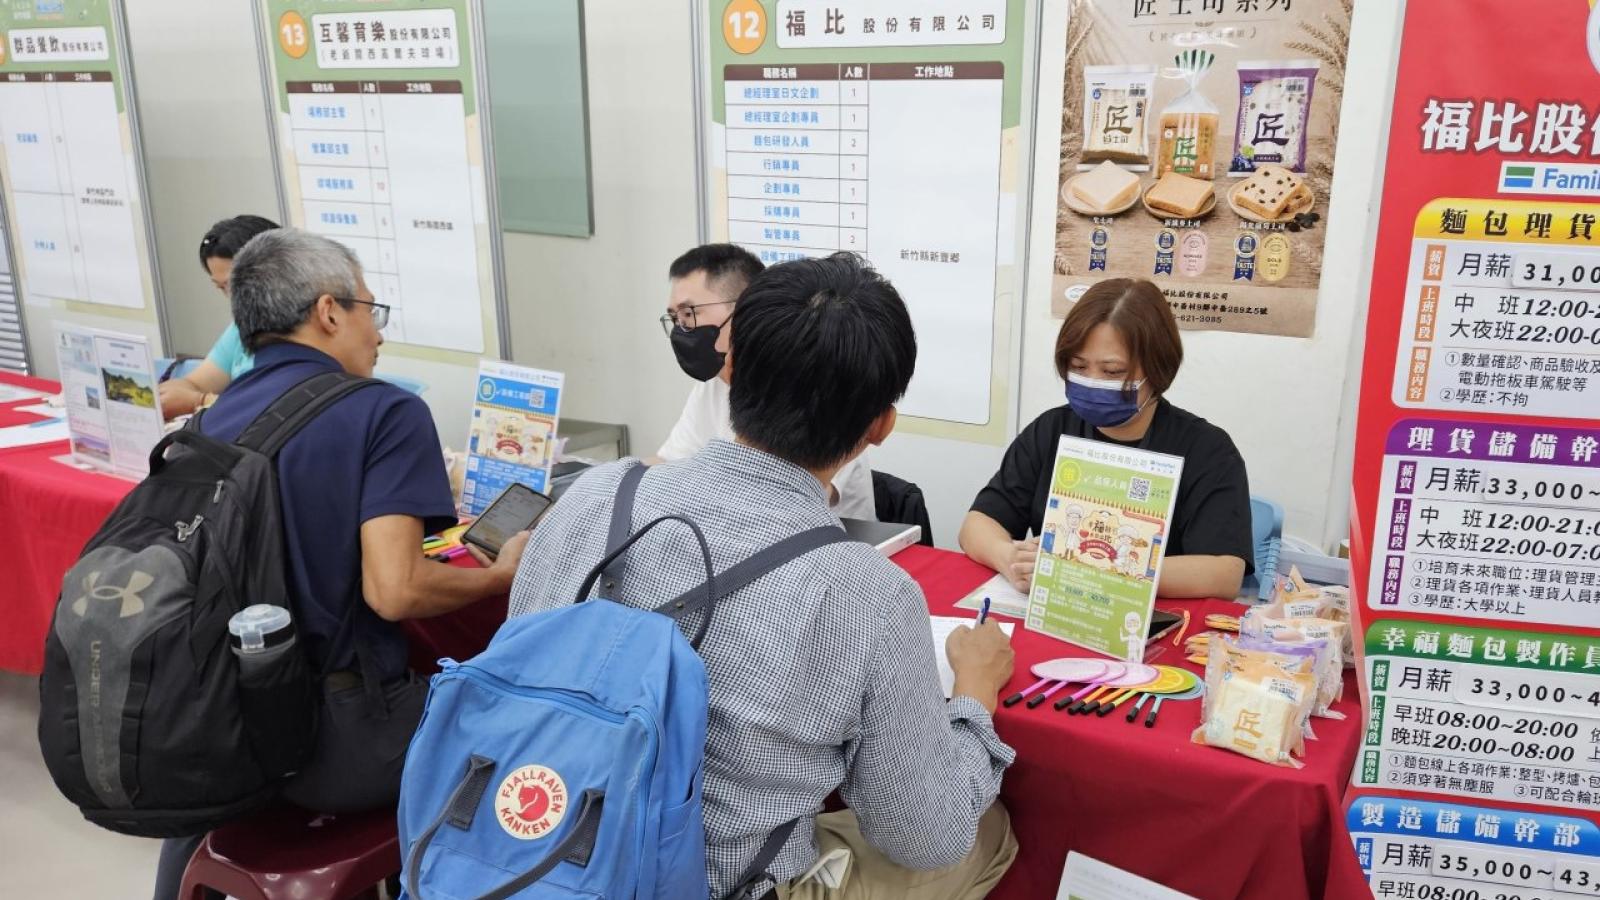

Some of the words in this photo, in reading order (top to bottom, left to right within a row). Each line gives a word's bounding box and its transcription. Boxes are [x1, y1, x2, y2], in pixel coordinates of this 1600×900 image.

[282, 22, 305, 46] 13
[728, 12, 760, 39] 12
[786, 8, 995, 36] 福比股份有限公司
[915, 66, 955, 78] 工作地點
[744, 87, 820, 99] 總經理室日文企劃
[744, 111, 819, 124] 總經理室企劃專員
[1103, 104, 1133, 134] 匠
[1251, 112, 1290, 146] 匠
[1421, 98, 1600, 155] 福比股
[754, 135, 810, 148] 麵包研發人員
[763, 159, 801, 171] 行銷專員
[763, 182, 801, 195] 企劃專員
[1440, 208, 1596, 240] 麵包理貨
[900, 249, 961, 263] 新竹縣新豐鄉
[1457, 252, 1511, 278] 月薪
[1418, 287, 1437, 340] 上班時段
[1454, 293, 1475, 313] 中
[1458, 371, 1588, 392] 電動拖板車駕駛等
[1407, 426, 1599, 462] 理貨儲備幹
[1425, 467, 1480, 493] 月薪
[1390, 500, 1409, 549] 上班時段
[1420, 506, 1439, 525] 中
[1381, 626, 1600, 669] 幸福麵包製作員
[1399, 666, 1453, 693] 月薪
[1394, 704, 1578, 739] 早班08:00~20:00
[1391, 728, 1575, 762] 晚班20:00~08:00
[1361, 803, 1581, 848] 製造儲備幹部
[1382, 842, 1432, 868] 月薪
